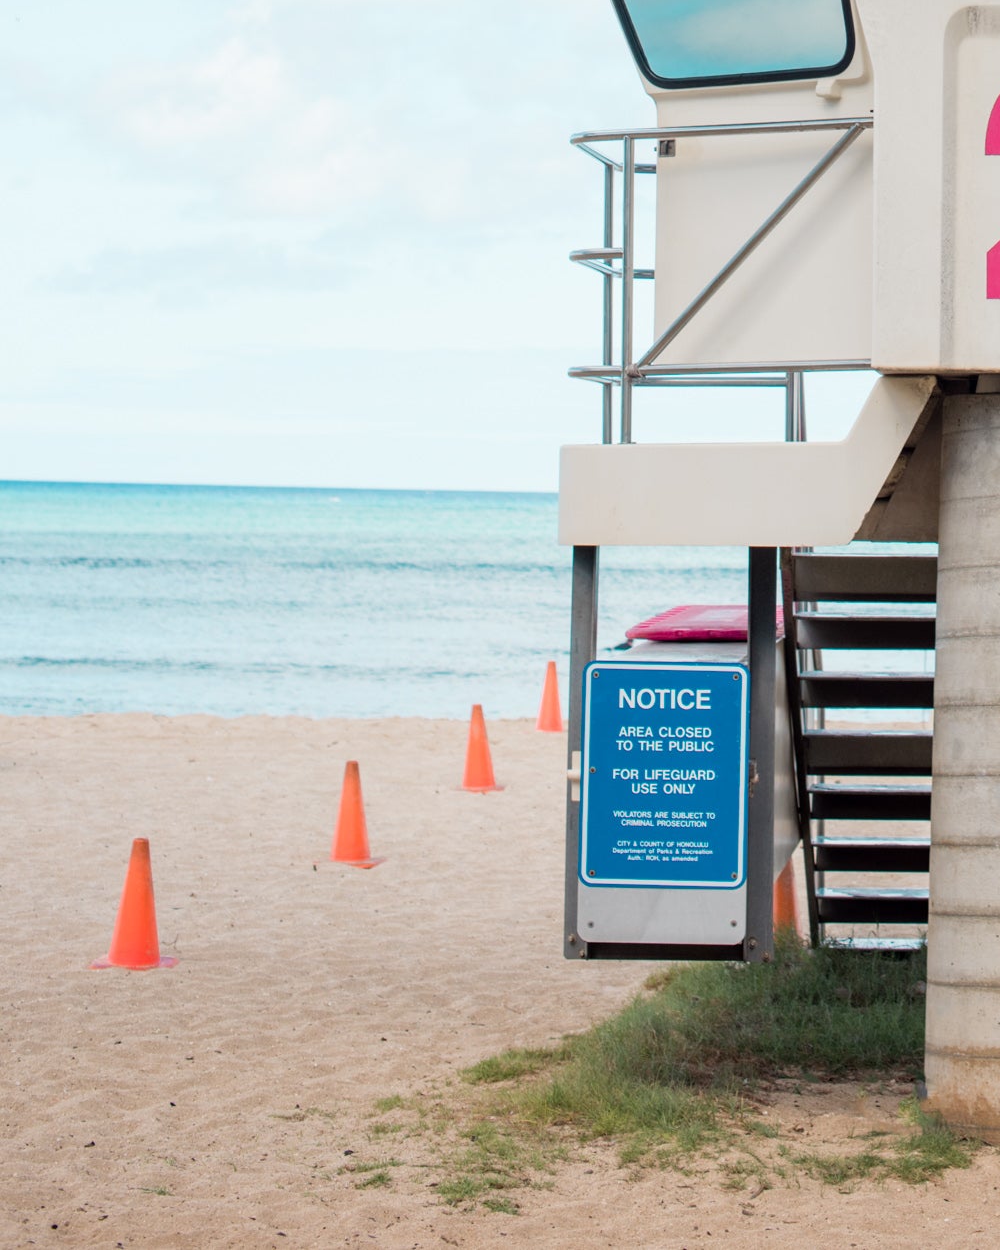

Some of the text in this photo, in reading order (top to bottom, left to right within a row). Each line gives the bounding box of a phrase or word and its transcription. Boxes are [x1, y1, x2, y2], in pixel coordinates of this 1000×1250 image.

[618, 688, 712, 710] NOTICE
[618, 726, 712, 738] AREA CLOSED
[616, 740, 715, 752] TO THE PUBLIC
[612, 768, 716, 781] FOR LIFEGUARD
[631, 783, 696, 795] USE ONLY
[612, 810, 716, 820] VIOLATORS ARE SUBJECT TO
[621, 819, 707, 828] CRIMINAL PROSECUTION
